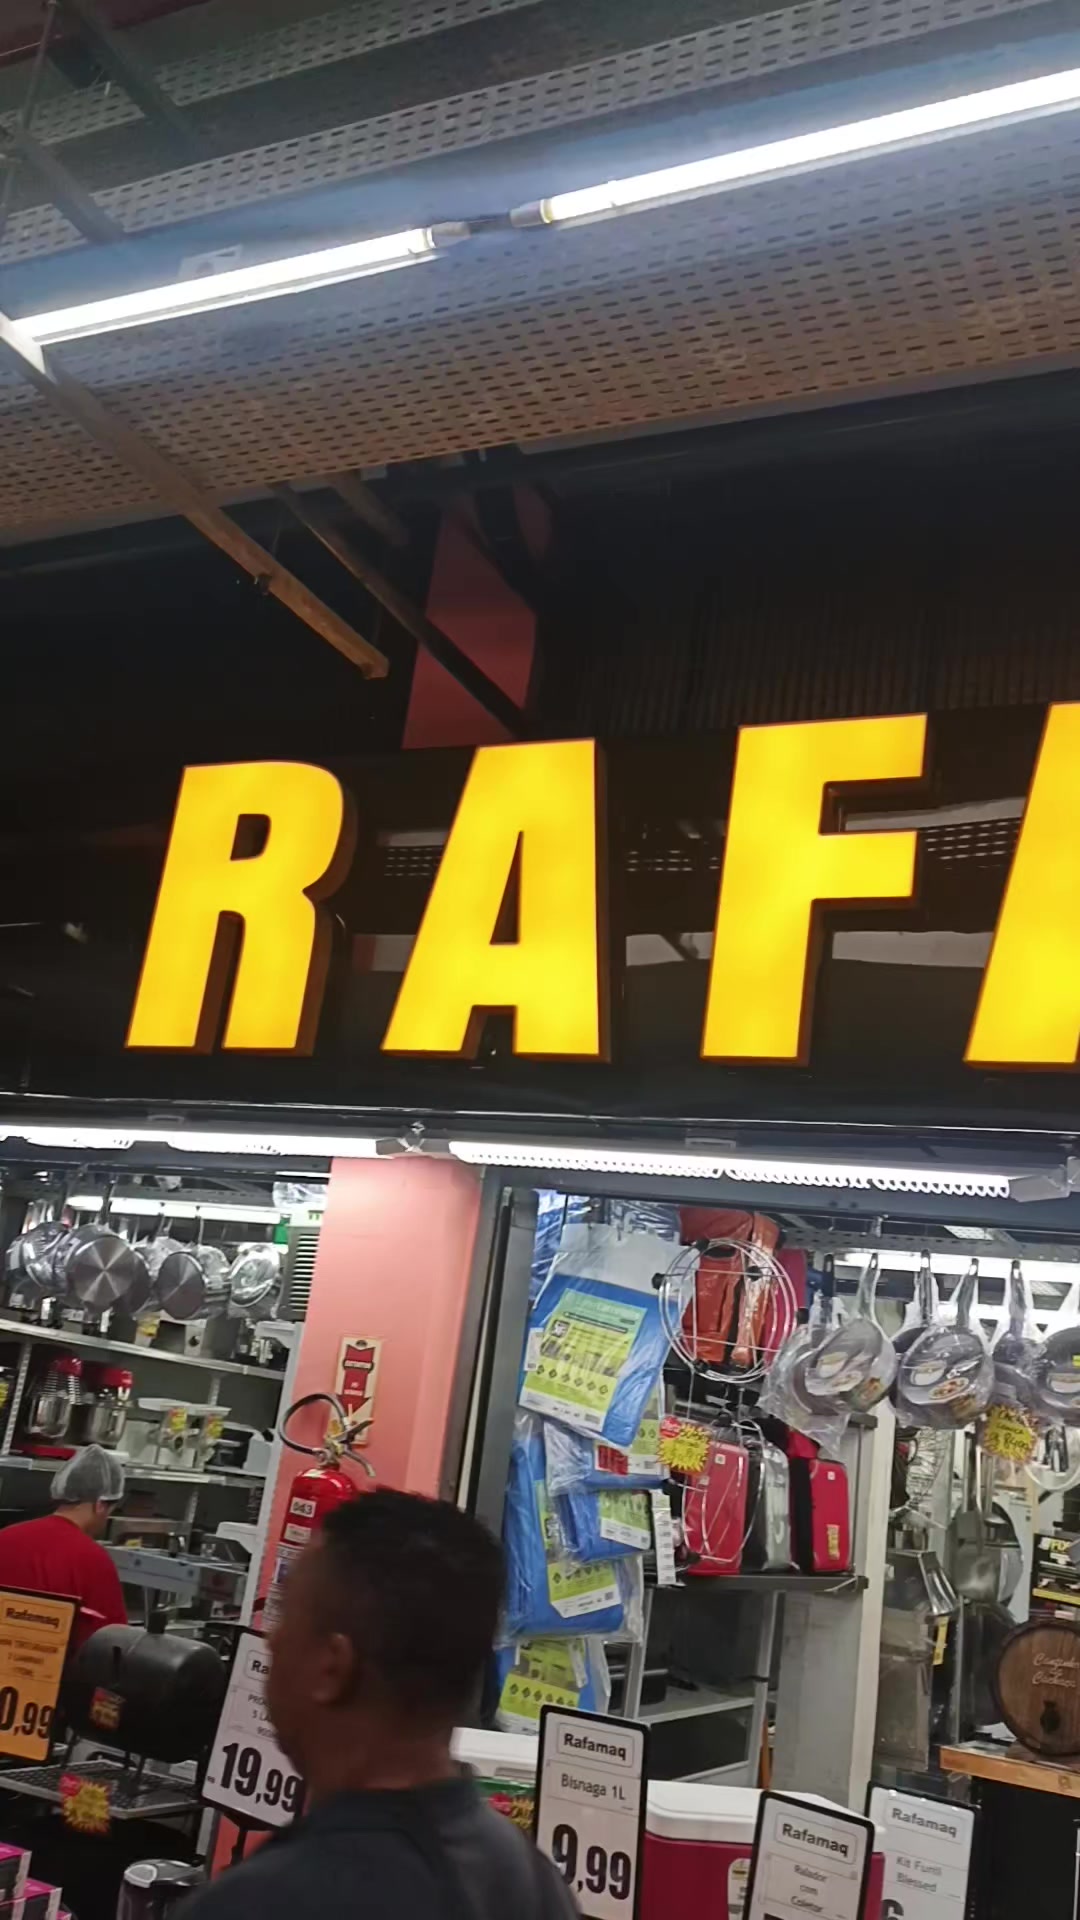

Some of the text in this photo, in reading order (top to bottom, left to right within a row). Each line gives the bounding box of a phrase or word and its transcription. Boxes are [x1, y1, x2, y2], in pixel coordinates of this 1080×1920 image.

[563, 1732, 626, 1761] Rafamaq
[220, 1742, 304, 1813] 19,99
[561, 1773, 627, 1801] Bisnaga 1L
[892, 1807, 957, 1838] Rafamaq
[782, 1823, 849, 1858] Rafamaq
[552, 1823, 632, 1900] 9,99
